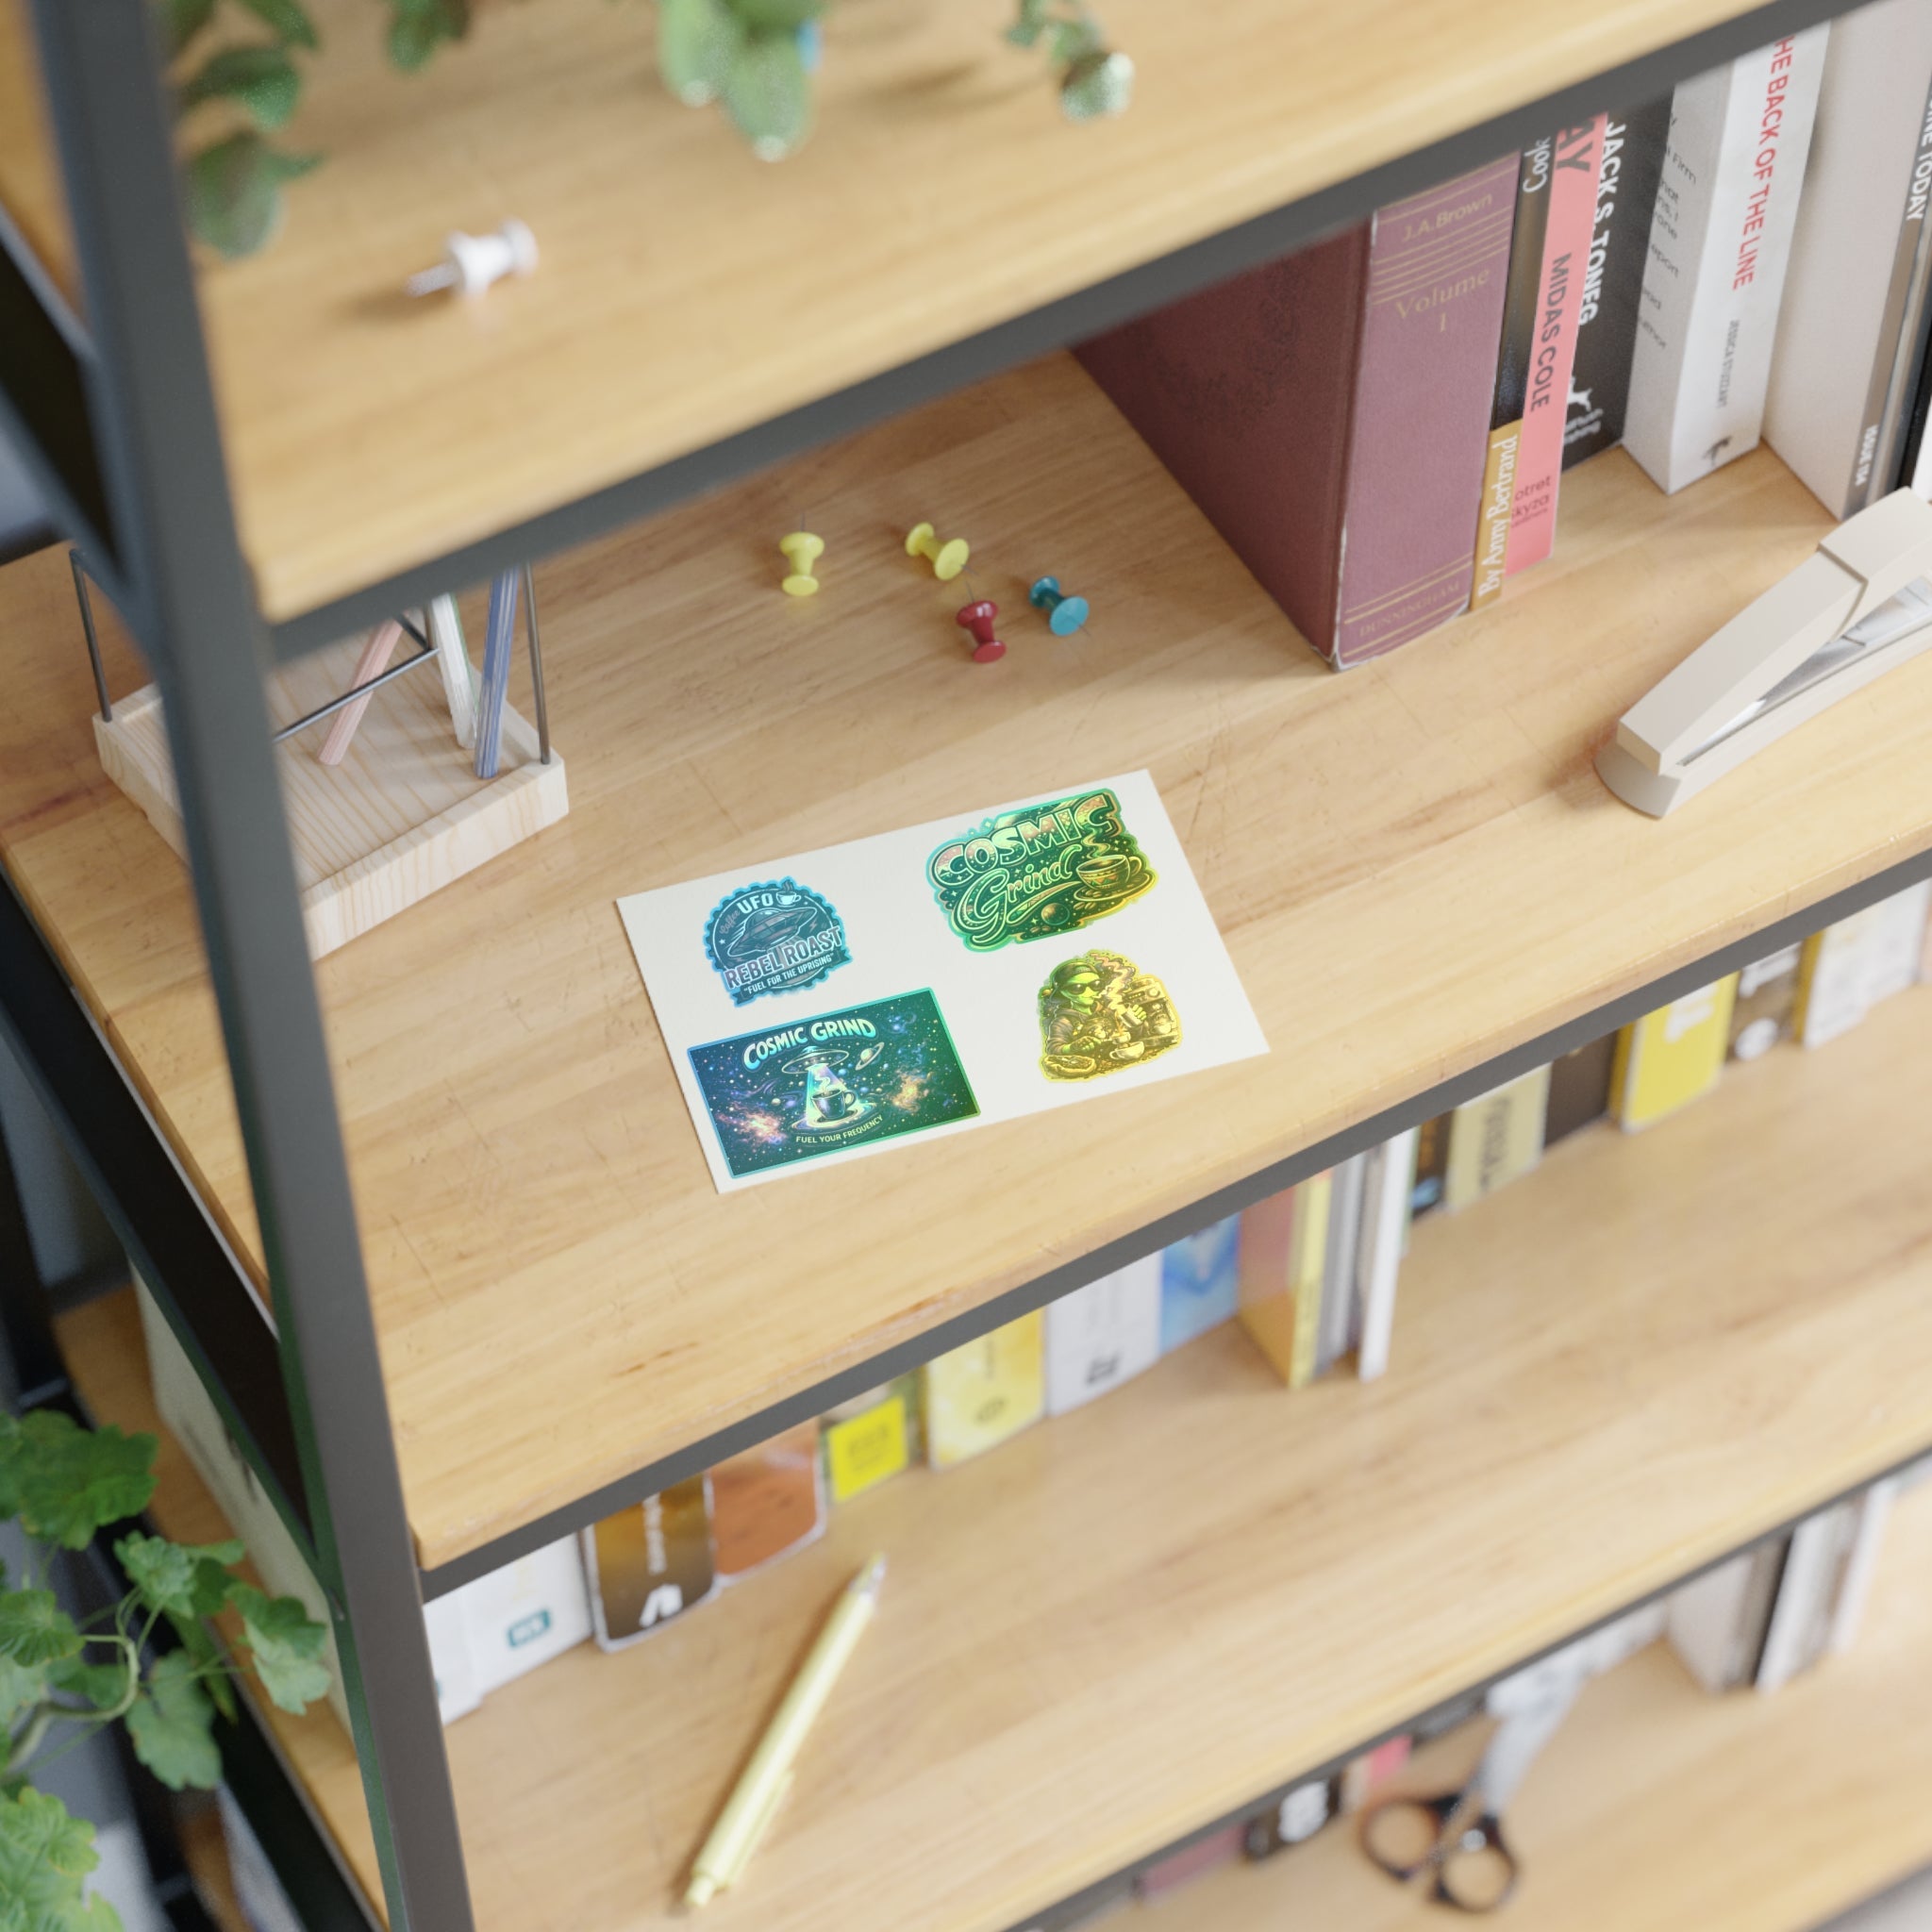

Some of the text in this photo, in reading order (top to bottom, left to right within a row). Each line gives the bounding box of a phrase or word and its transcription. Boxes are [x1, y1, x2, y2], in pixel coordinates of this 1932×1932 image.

[1557, 119, 1596, 173] AY
[1598, 122, 1626, 199] JACK
[1732, 34, 1796, 291] HE BACK OF THE LINE
[1395, 270, 1491, 320] Volume
[1530, 252, 1572, 413] MIDAS COLE
[1486, 434, 1518, 520] Bertrand
[1477, 568, 1504, 597] By
[932, 792, 1114, 886] COSMIC
[737, 892, 774, 914] UFO
[956, 843, 1083, 944] Grind
[724, 925, 842, 990] REBEL ROAST
[766, 975, 782, 987] FOR
[782, 969, 797, 981] THE
[743, 1018, 876, 1070] COSMIC GRIND
[819, 1133, 842, 1142] YOUR
[842, 1115, 884, 1139] FREQUENCY
